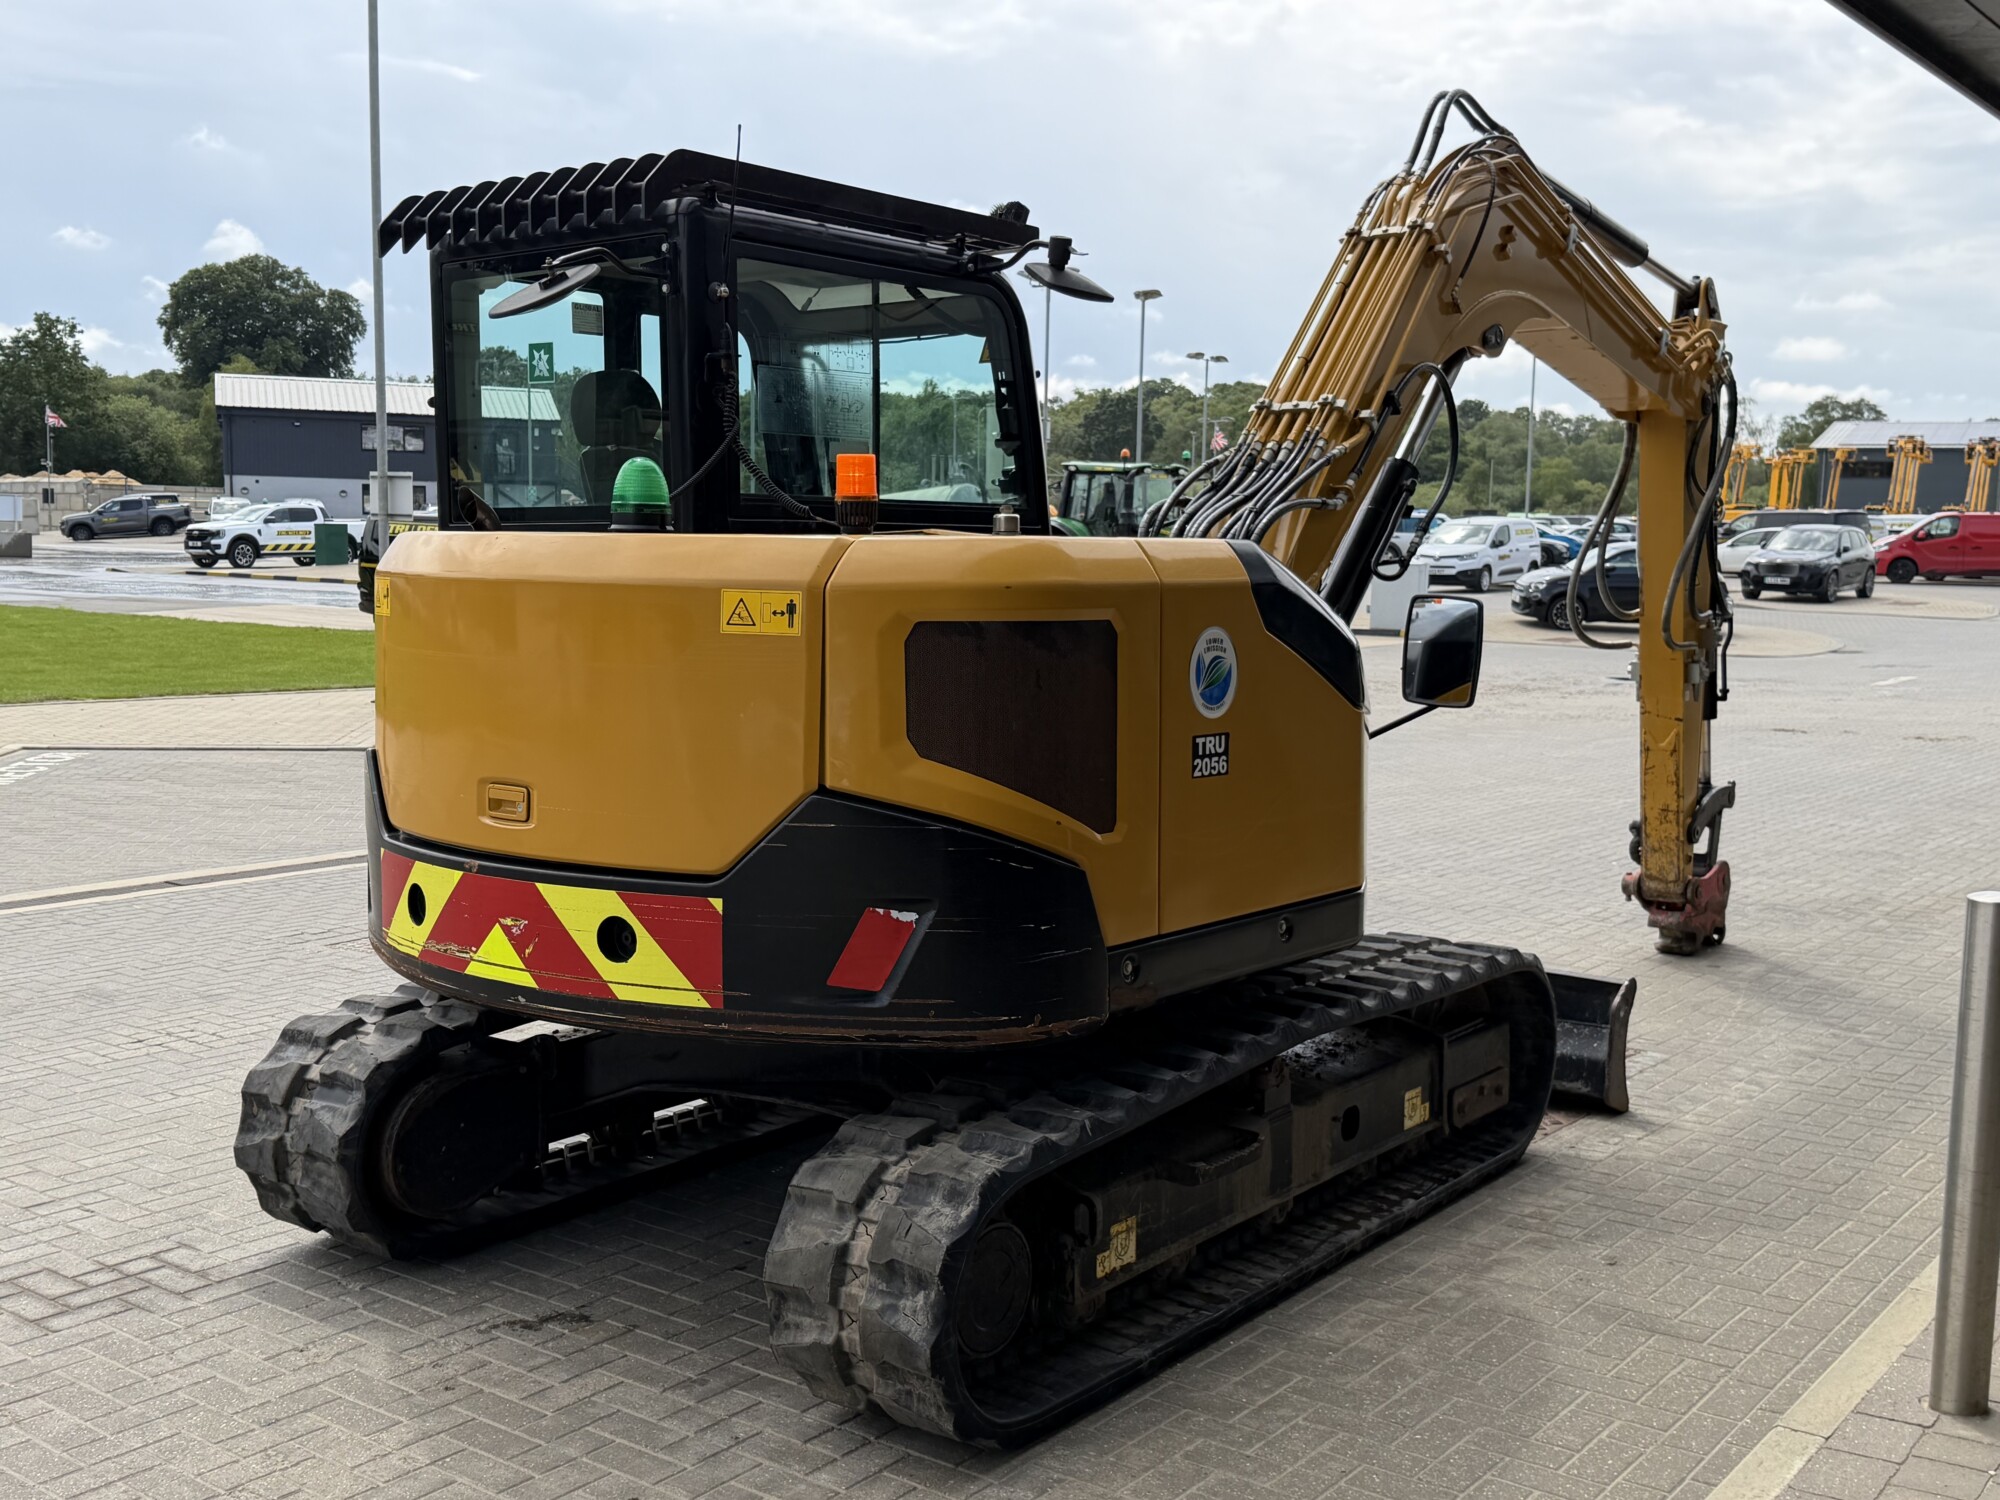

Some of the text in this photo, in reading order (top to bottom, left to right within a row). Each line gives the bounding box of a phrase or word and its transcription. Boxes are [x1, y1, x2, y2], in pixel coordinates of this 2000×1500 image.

[1203, 644, 1227, 654] EMISSION
[1205, 637, 1224, 646] LOWER
[1195, 735, 1225, 755] TRU
[1193, 756, 1228, 777] 2056
